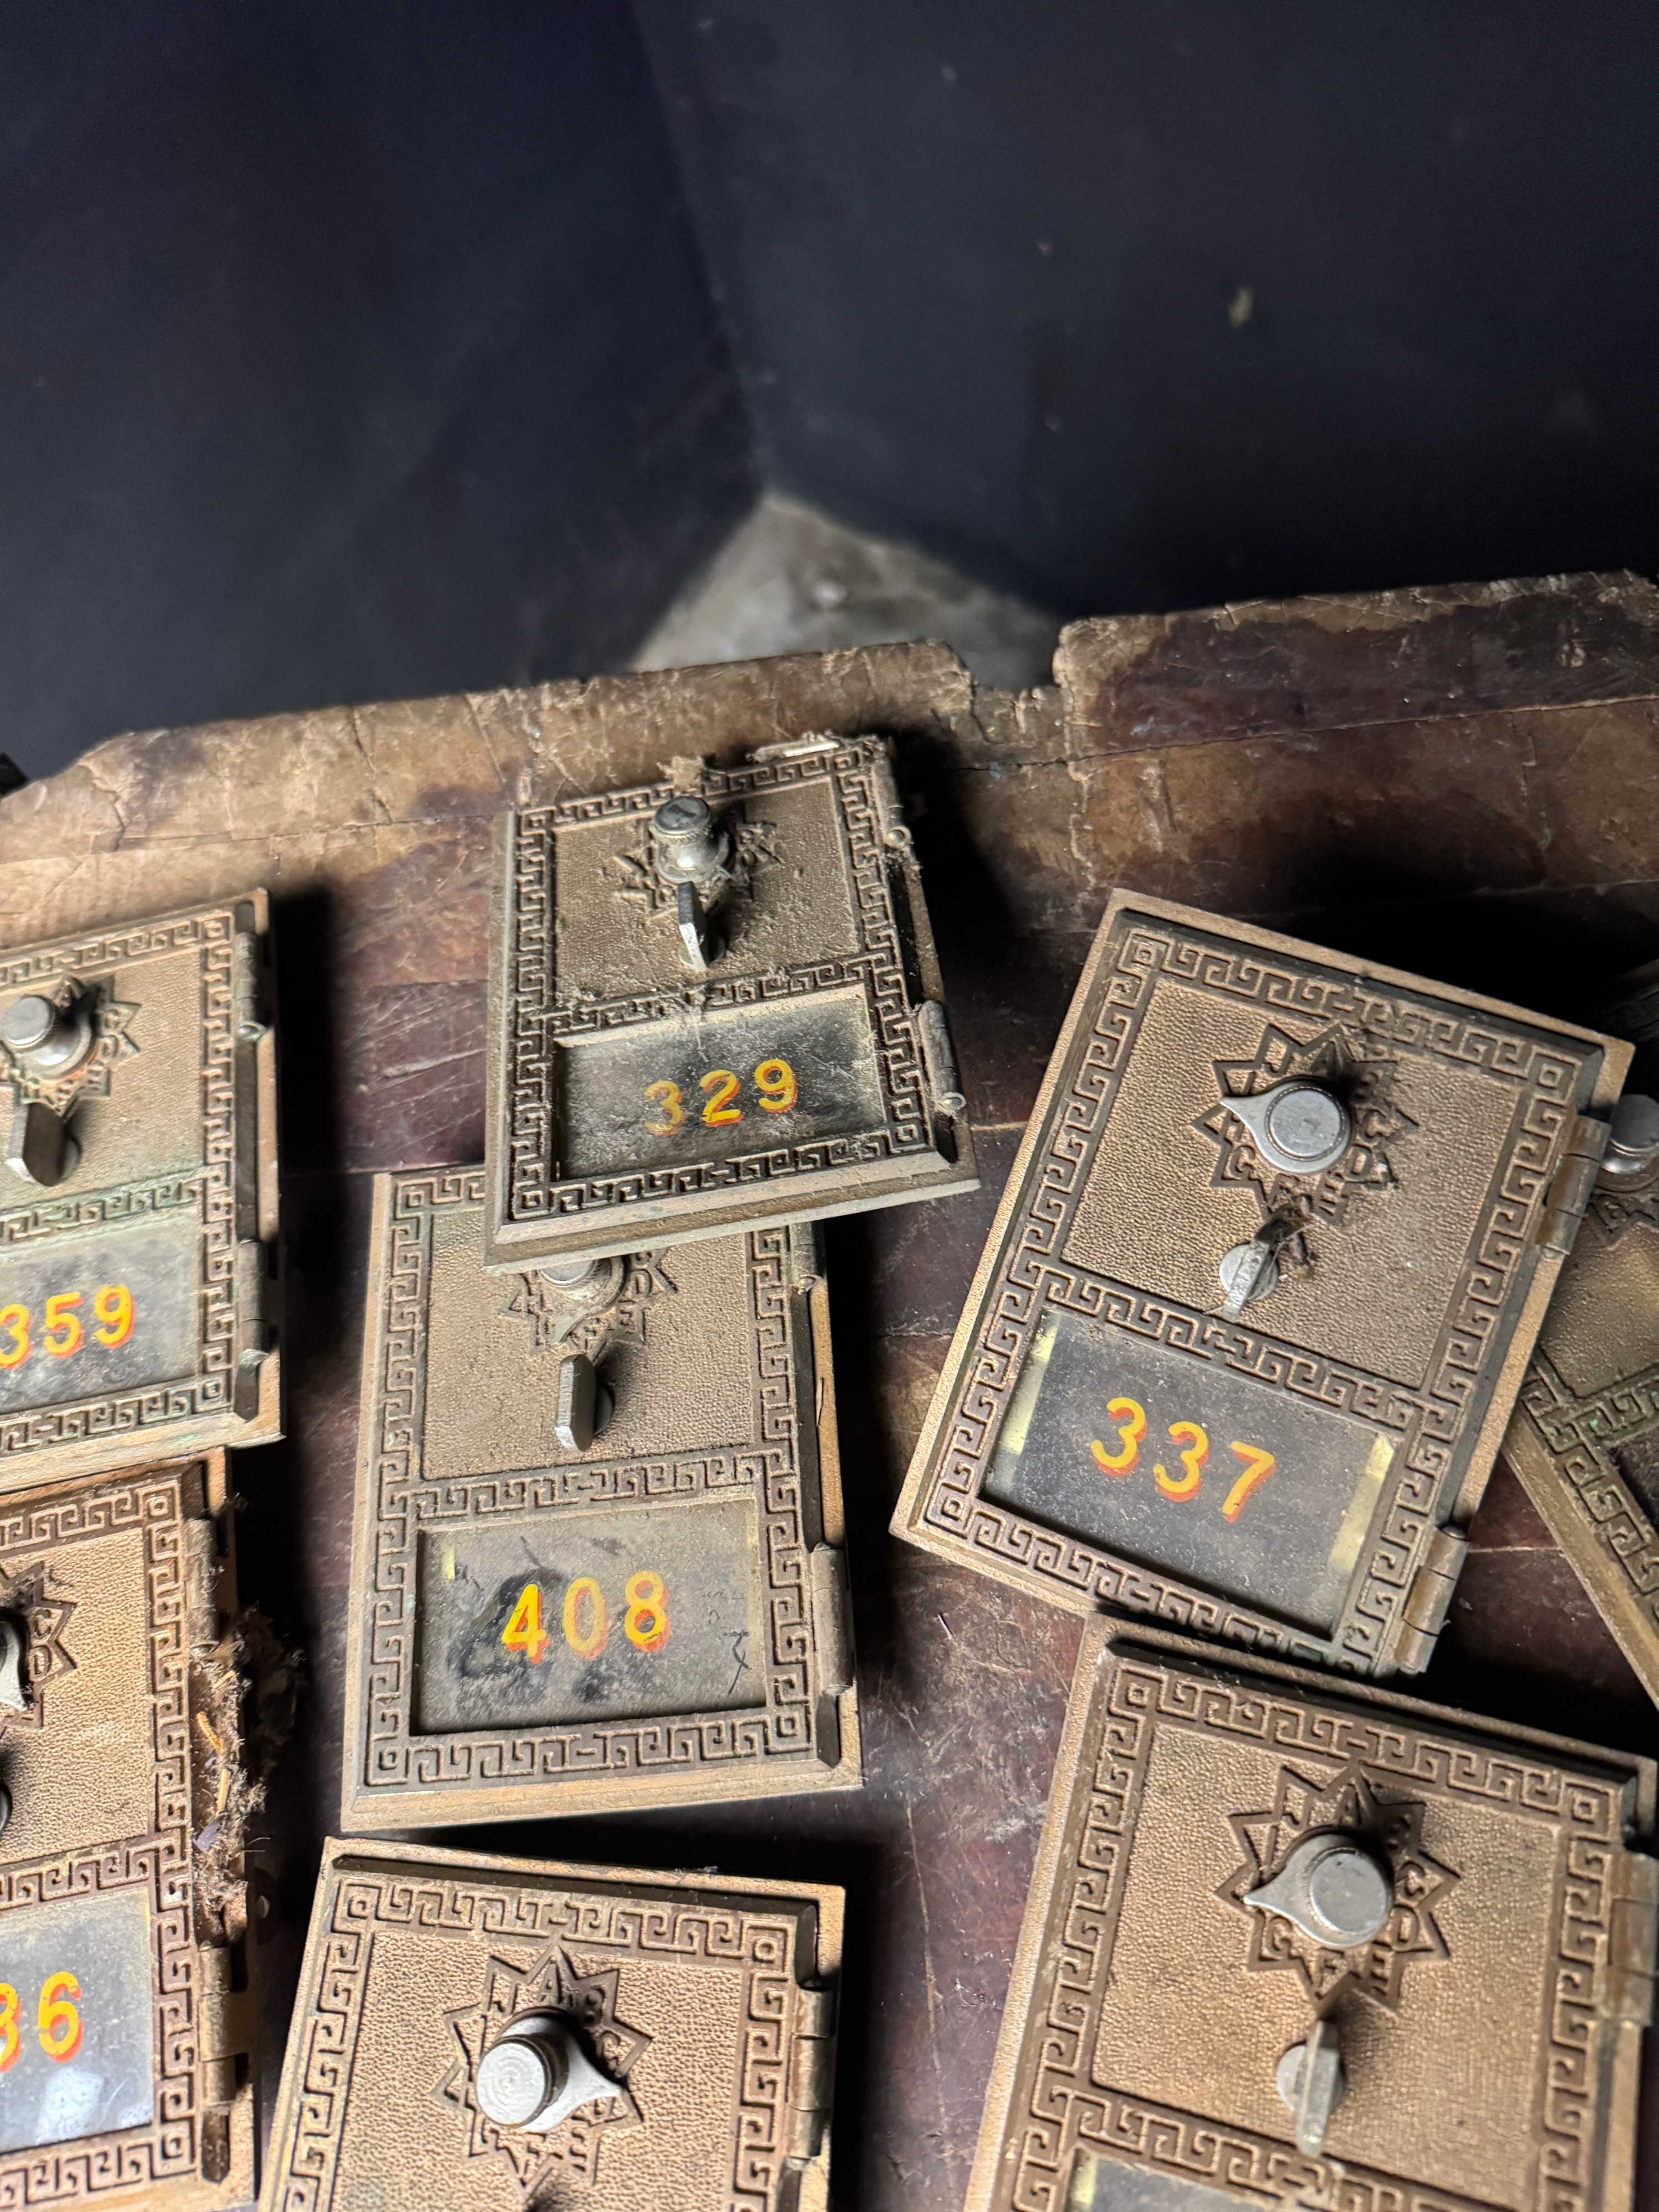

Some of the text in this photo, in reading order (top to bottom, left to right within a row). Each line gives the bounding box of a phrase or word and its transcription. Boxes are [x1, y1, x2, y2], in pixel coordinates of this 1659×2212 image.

[643, 1058, 798, 1137] 329
[0, 1284, 135, 1369] 359
[1091, 1397, 1276, 1524] 337
[501, 1570, 671, 1665] 408
